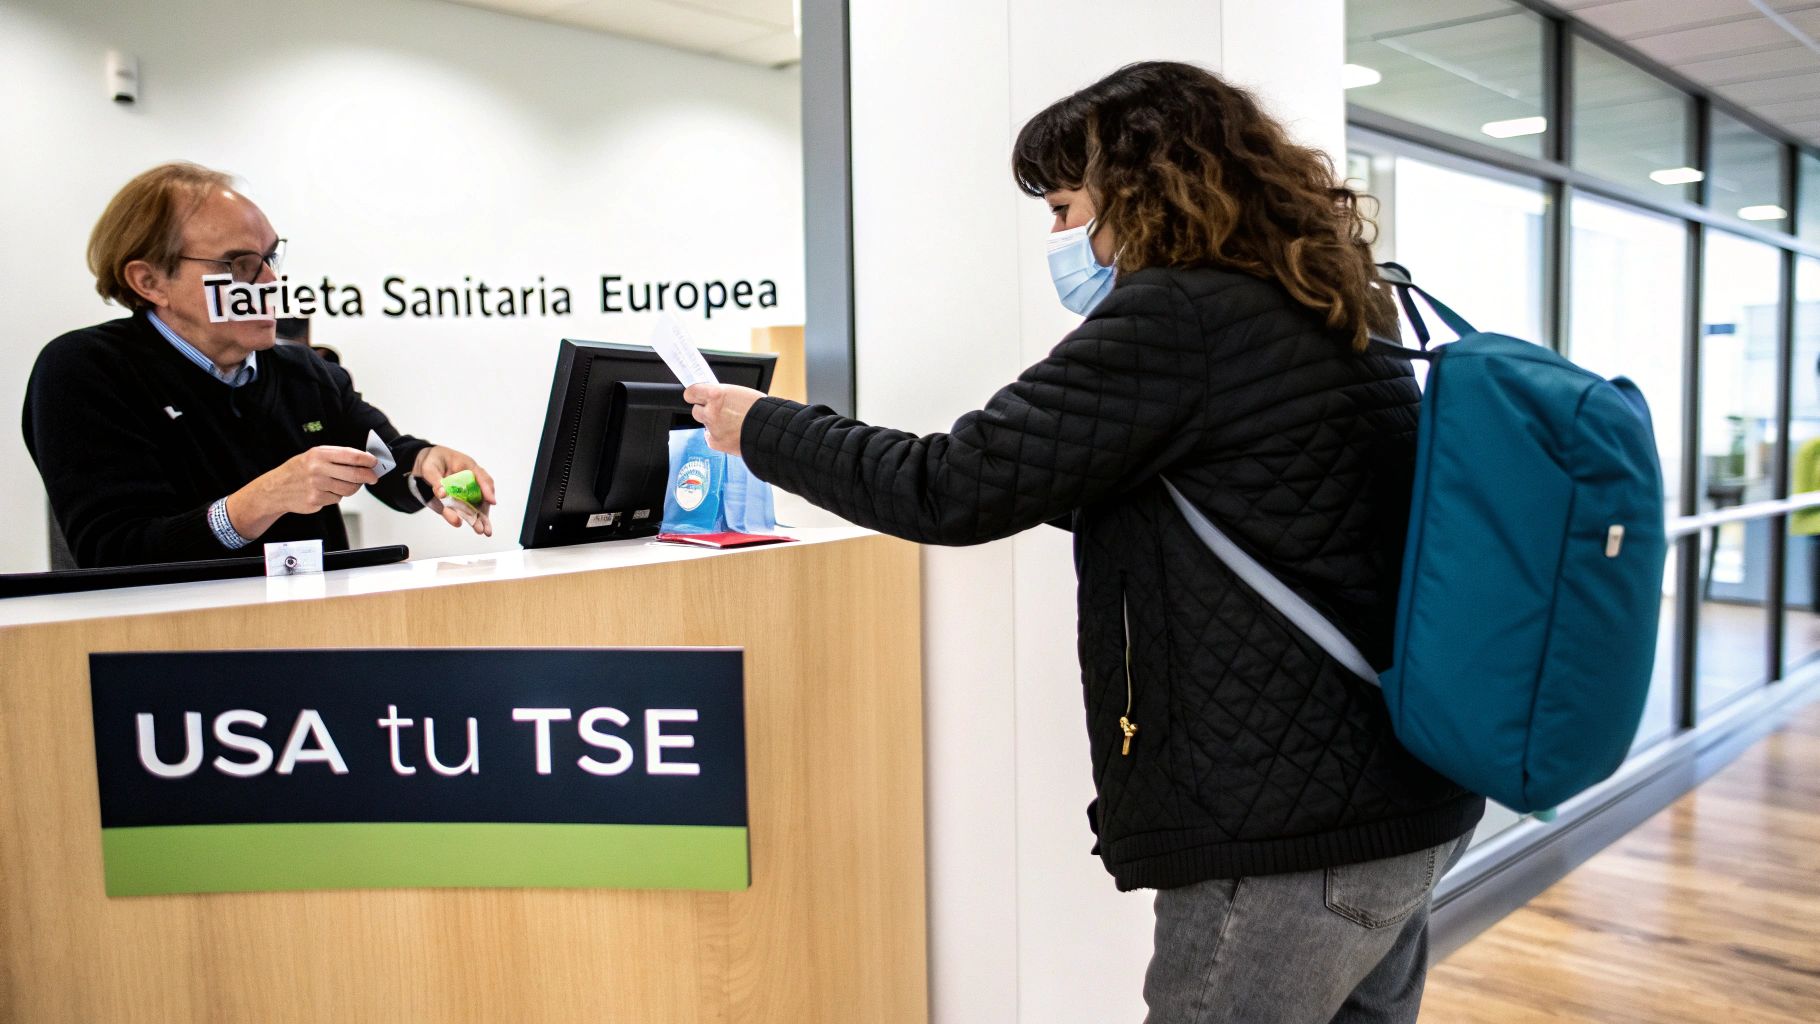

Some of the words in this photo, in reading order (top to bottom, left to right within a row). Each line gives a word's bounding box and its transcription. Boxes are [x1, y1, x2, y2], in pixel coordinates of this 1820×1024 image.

[383, 276, 571, 317] Sanitaria
[601, 275, 778, 318] Europea
[136, 709, 349, 778] USA
[377, 704, 480, 778] tu
[511, 706, 702, 777] TSE
